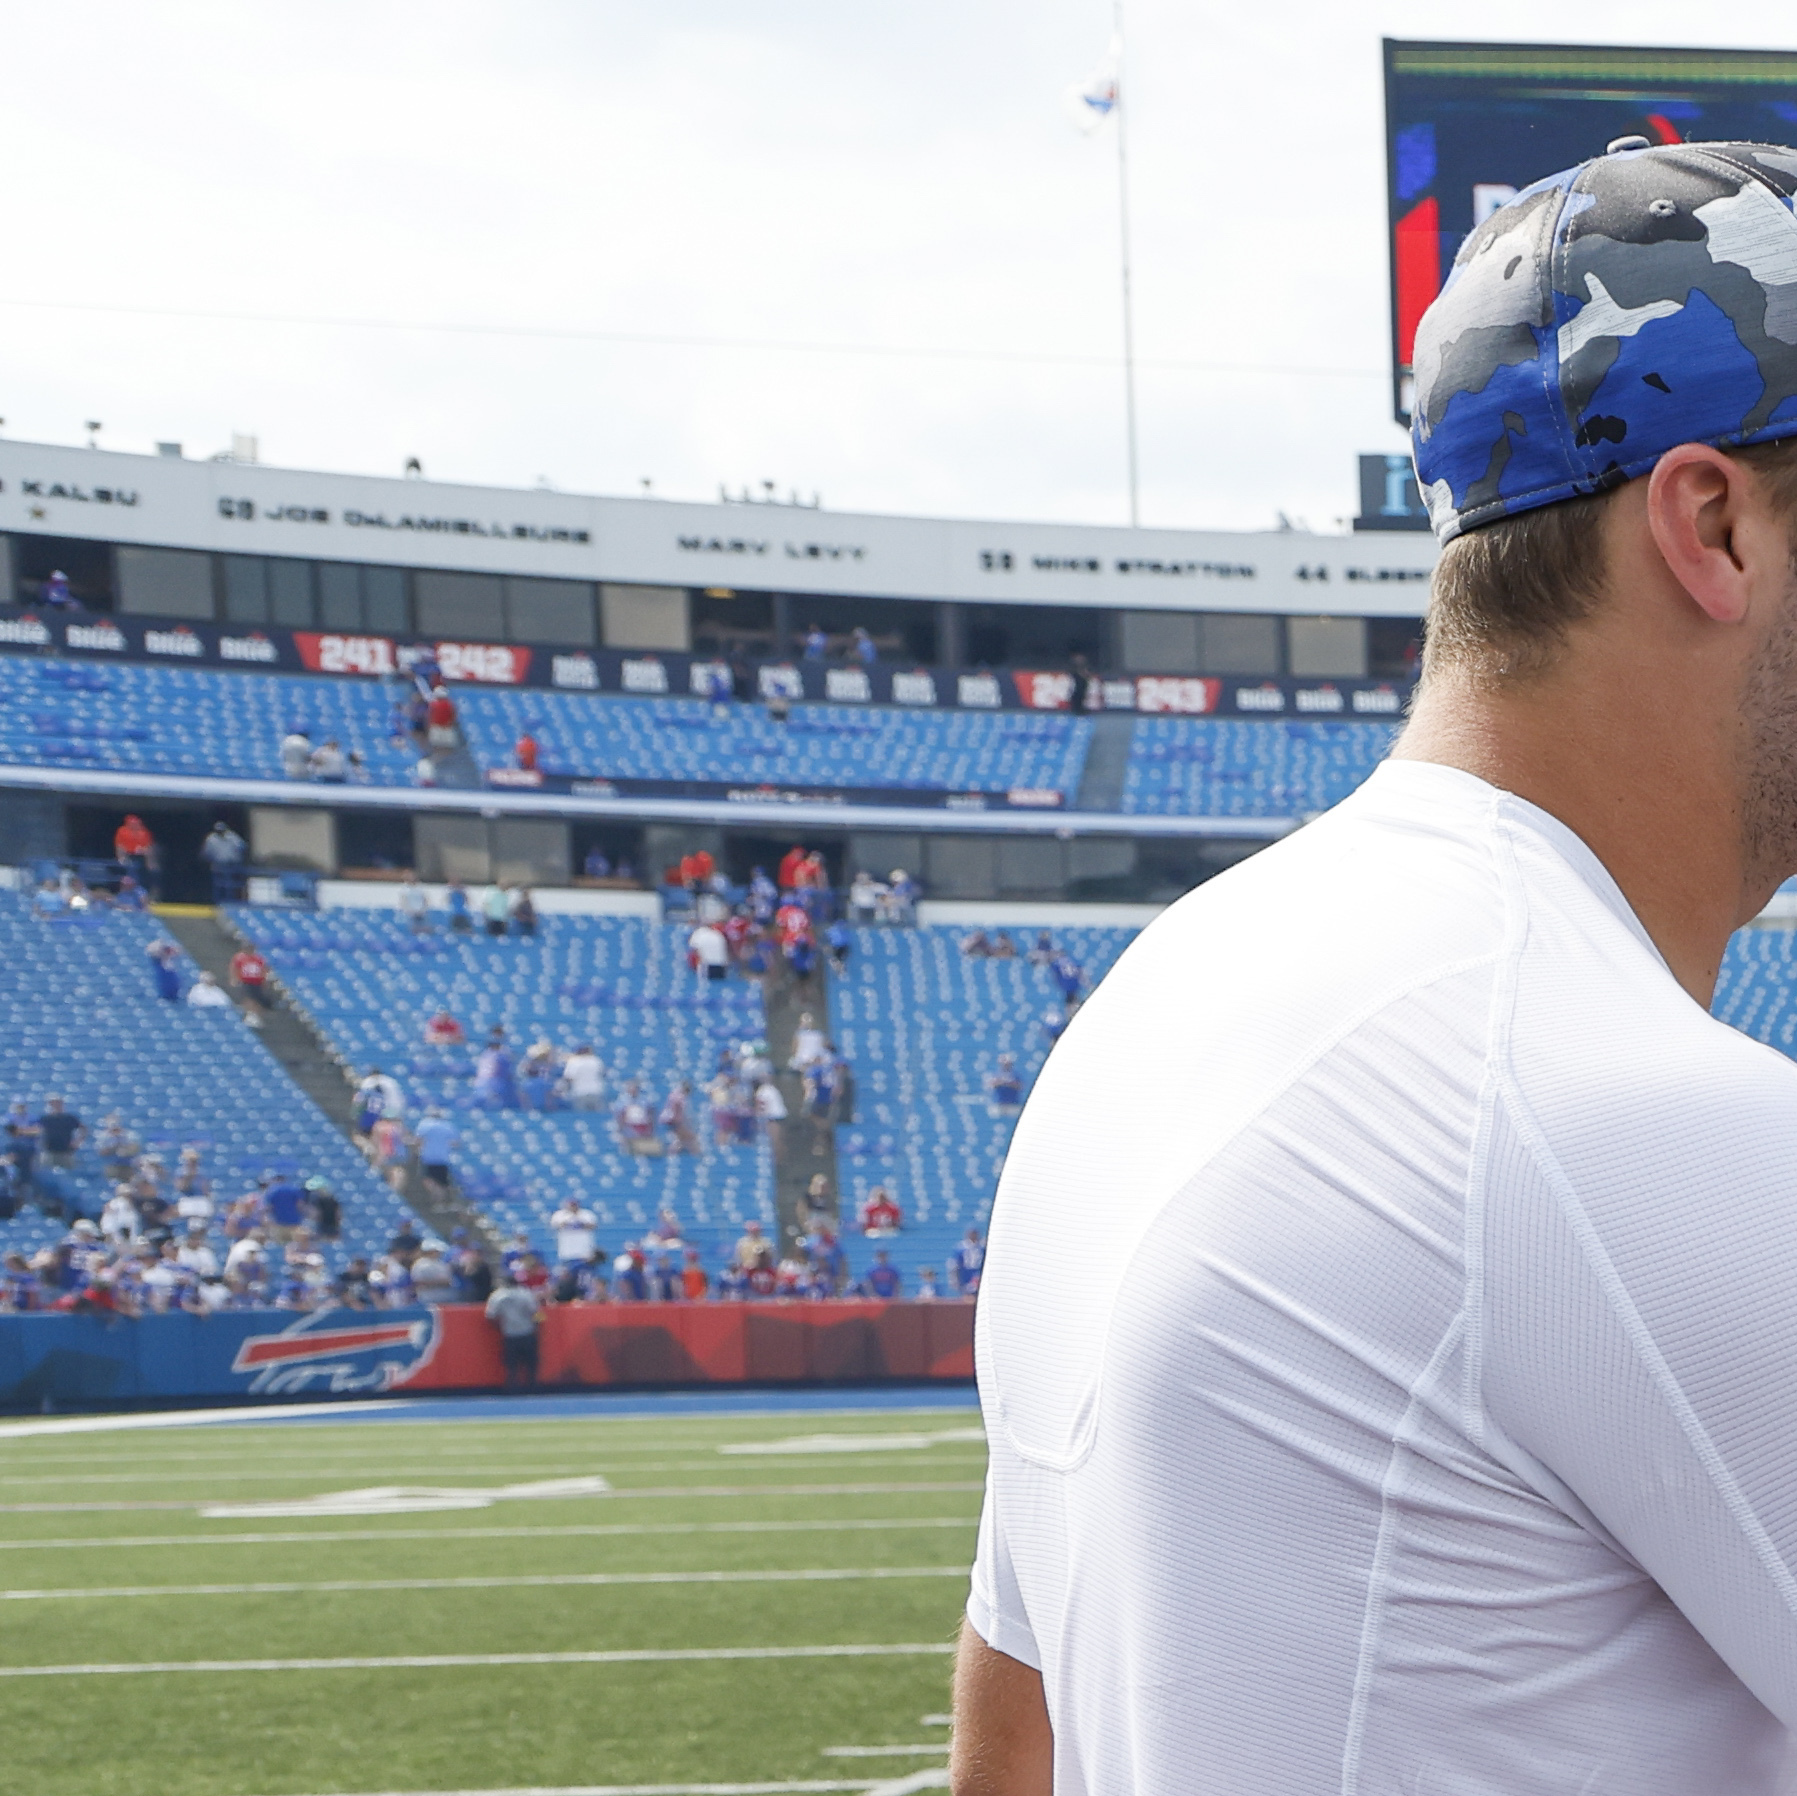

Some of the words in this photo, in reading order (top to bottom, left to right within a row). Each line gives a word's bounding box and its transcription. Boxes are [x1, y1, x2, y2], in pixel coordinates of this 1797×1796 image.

[265, 508, 329, 524] JOE
[1032, 555, 1101, 577] MIKE
[1118, 560, 1257, 581] STRATTON
[319, 635, 393, 674] 241
[434, 643, 515, 683] 242
